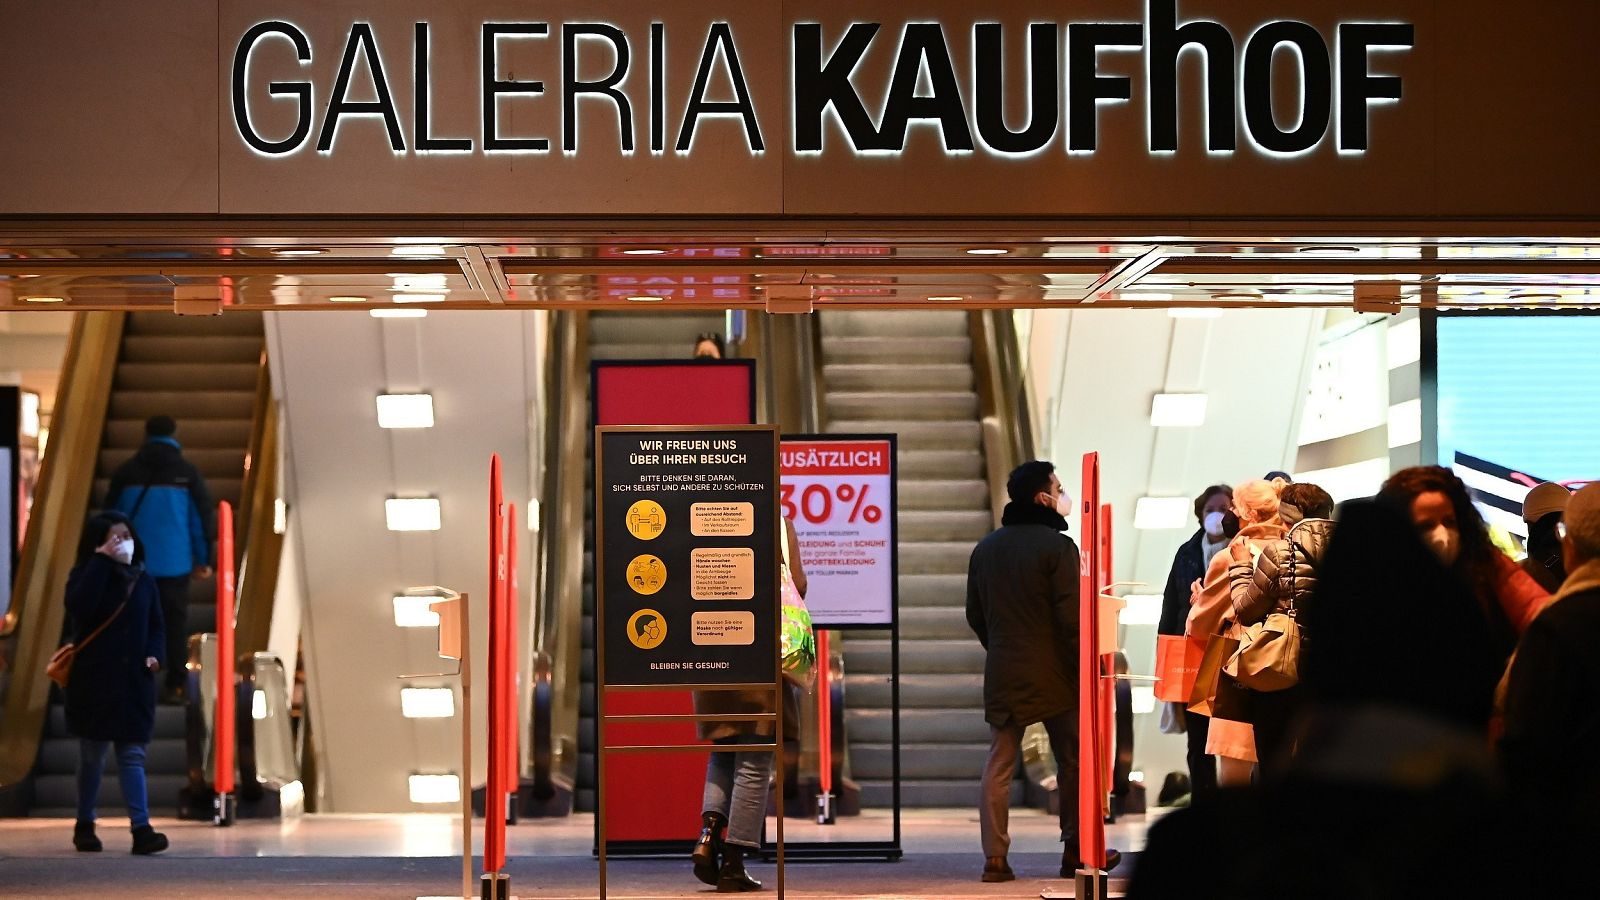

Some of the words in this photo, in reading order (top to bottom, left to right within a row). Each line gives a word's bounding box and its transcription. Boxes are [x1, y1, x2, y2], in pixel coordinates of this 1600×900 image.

[231, 21, 765, 154] GALERIA
[793, 0, 1415, 154] KAUFhOF
[640, 440, 663, 450] WIR
[666, 440, 710, 450] FREUEN
[713, 440, 737, 450] UNS
[629, 453, 660, 464] ÜBER
[663, 454, 697, 464] IHREN
[700, 454, 747, 464] BESUCH
[780, 449, 881, 467] USÄTZLICH
